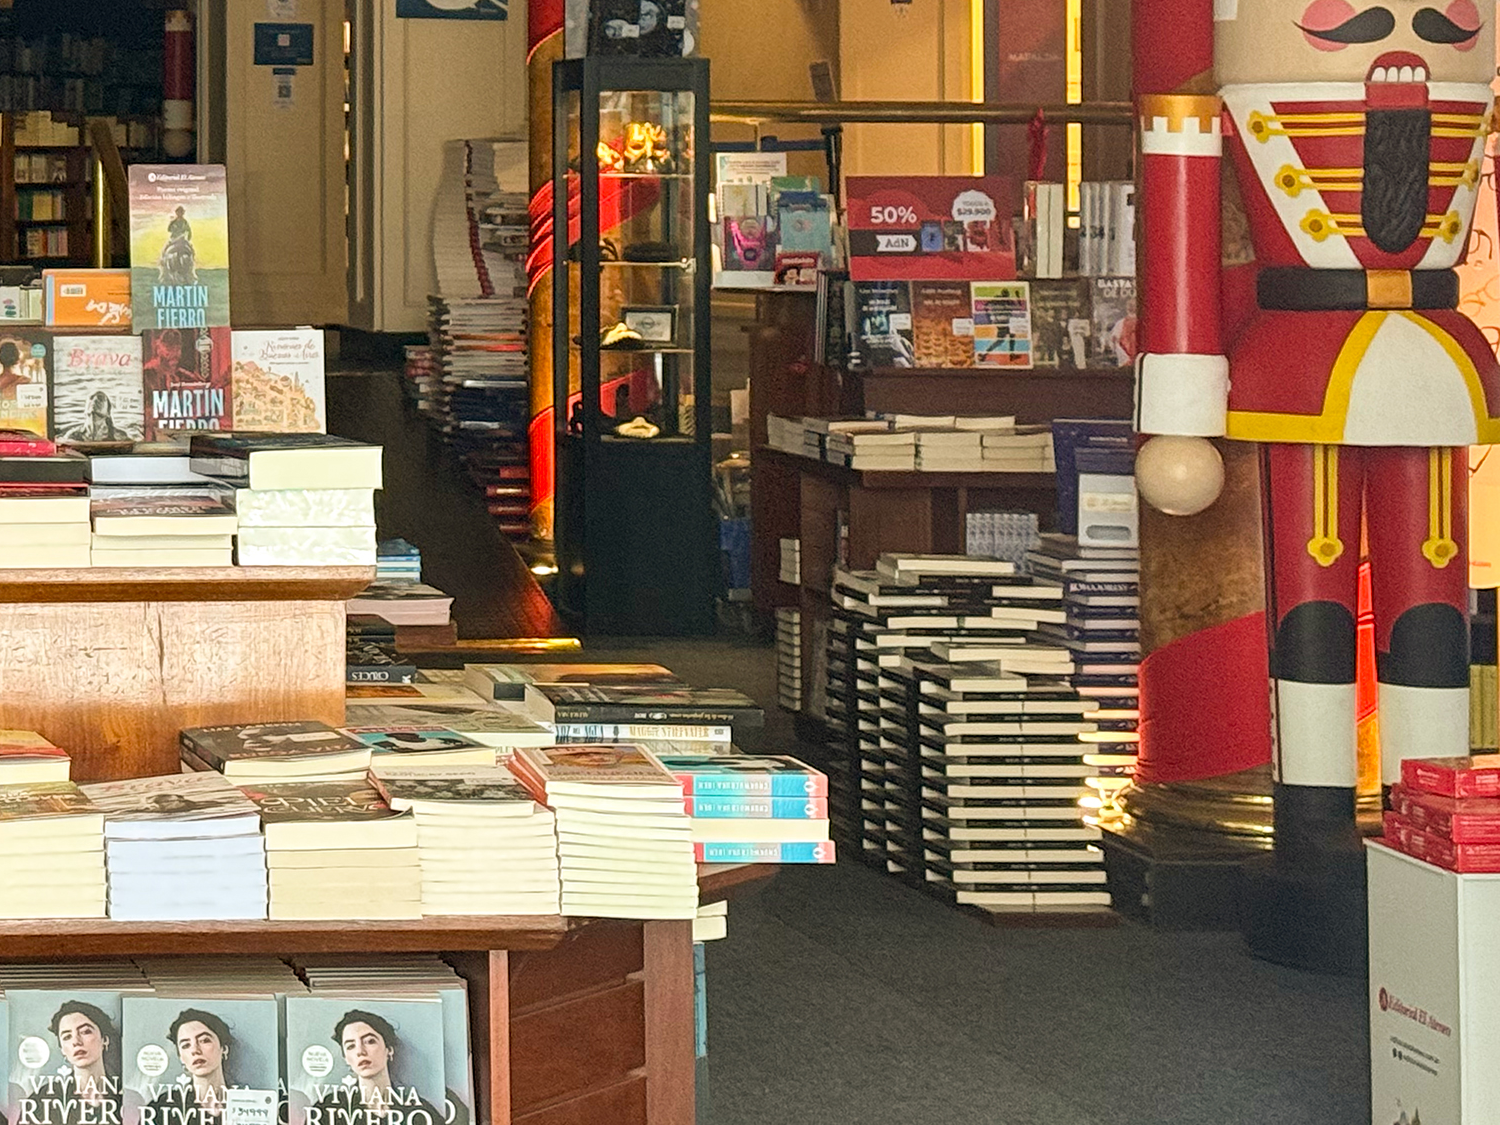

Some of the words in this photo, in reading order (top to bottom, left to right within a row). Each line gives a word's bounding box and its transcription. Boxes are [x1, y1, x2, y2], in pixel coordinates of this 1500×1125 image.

[870, 206, 917, 225] 50%
[884, 236, 910, 250] AdN
[153, 280, 209, 308] MARTÍN
[68, 347, 132, 368] Brava
[152, 384, 225, 419] MARTÍN
[351, 670, 390, 682] CRUCES
[29, 1074, 124, 1096] VIVIAN
[313, 1083, 423, 1106] VIVIANA
[18, 1098, 124, 1125] RIVER
[304, 1107, 433, 1125] RIVERO
